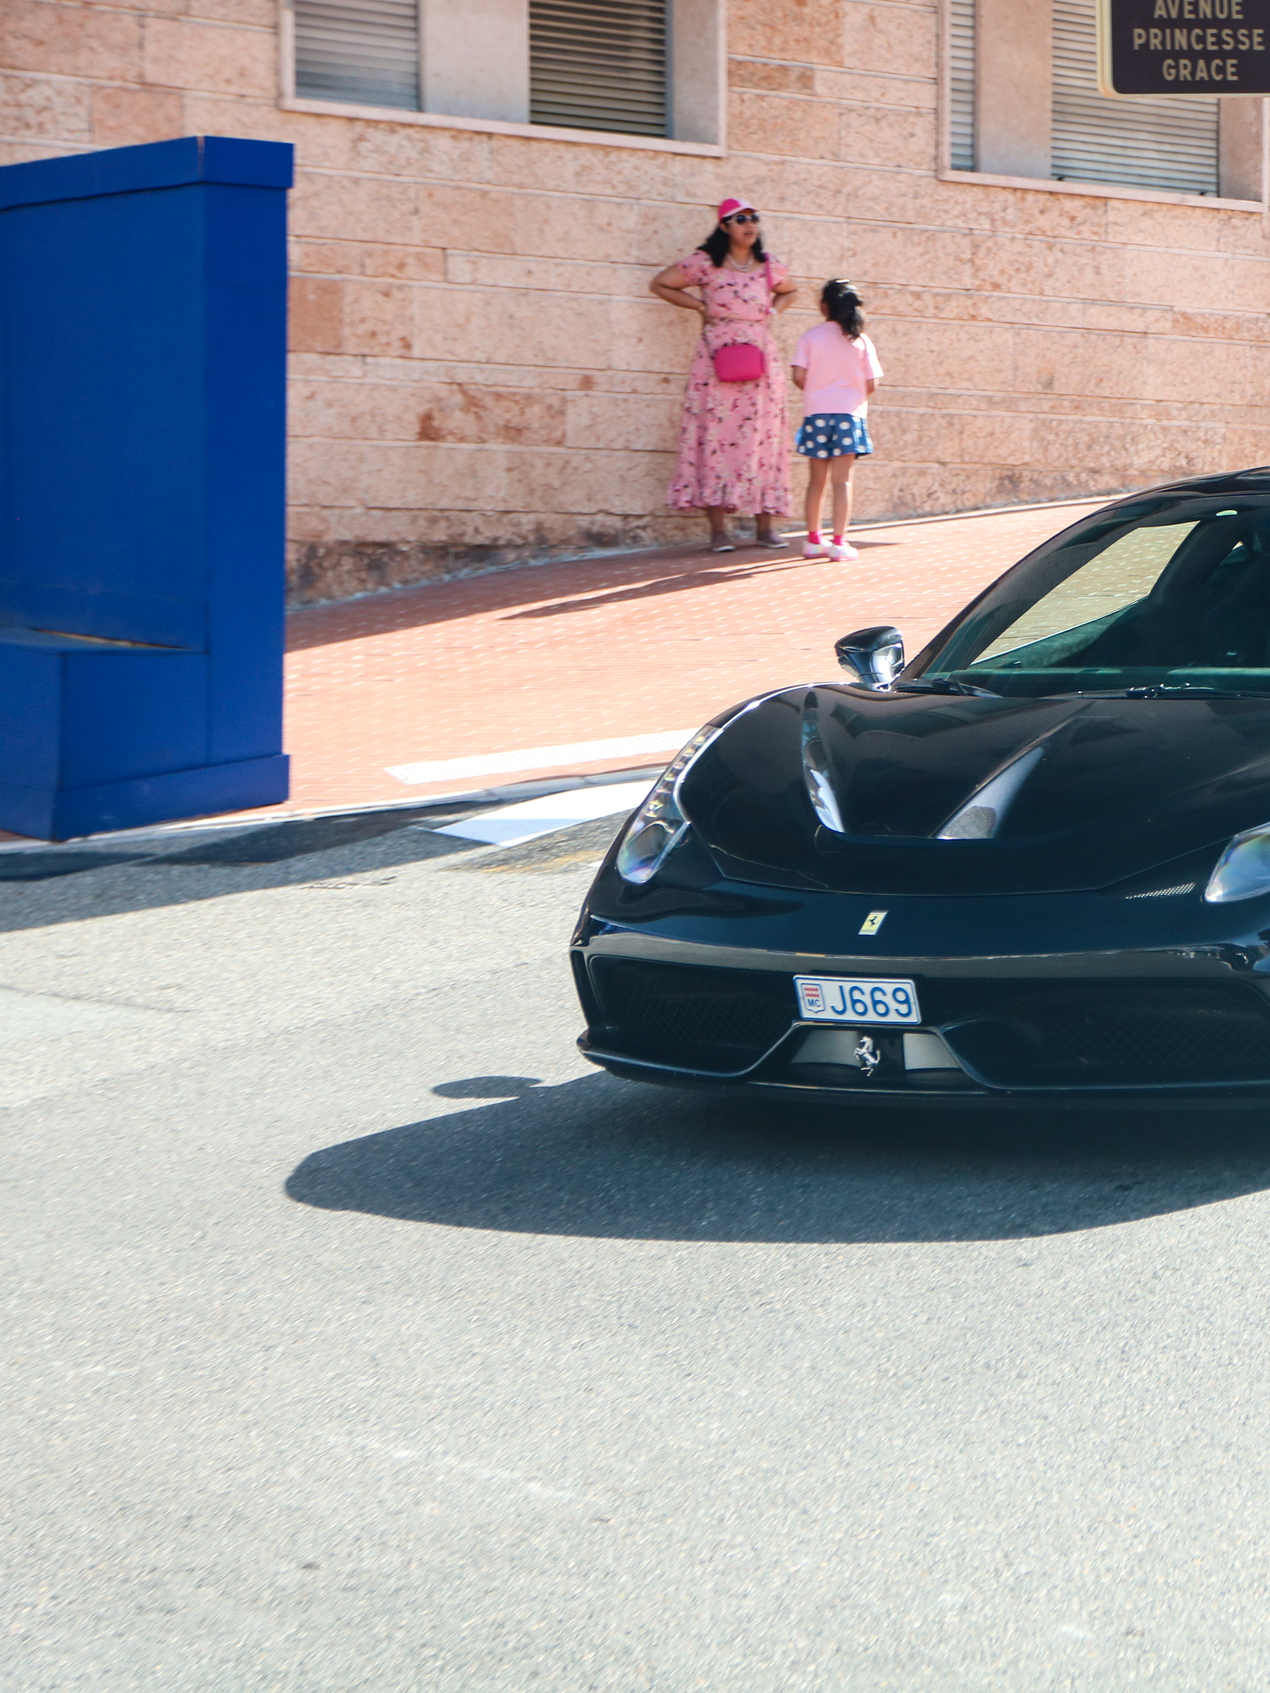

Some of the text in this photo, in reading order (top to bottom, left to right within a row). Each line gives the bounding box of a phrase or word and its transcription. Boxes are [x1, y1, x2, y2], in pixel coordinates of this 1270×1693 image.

[1154, 0, 1244, 19] AVENUE
[1133, 28, 1265, 50] PRINCESSE
[1162, 59, 1239, 81] GRACE
[808, 998, 822, 1008] MC
[831, 985, 912, 1018] J669
